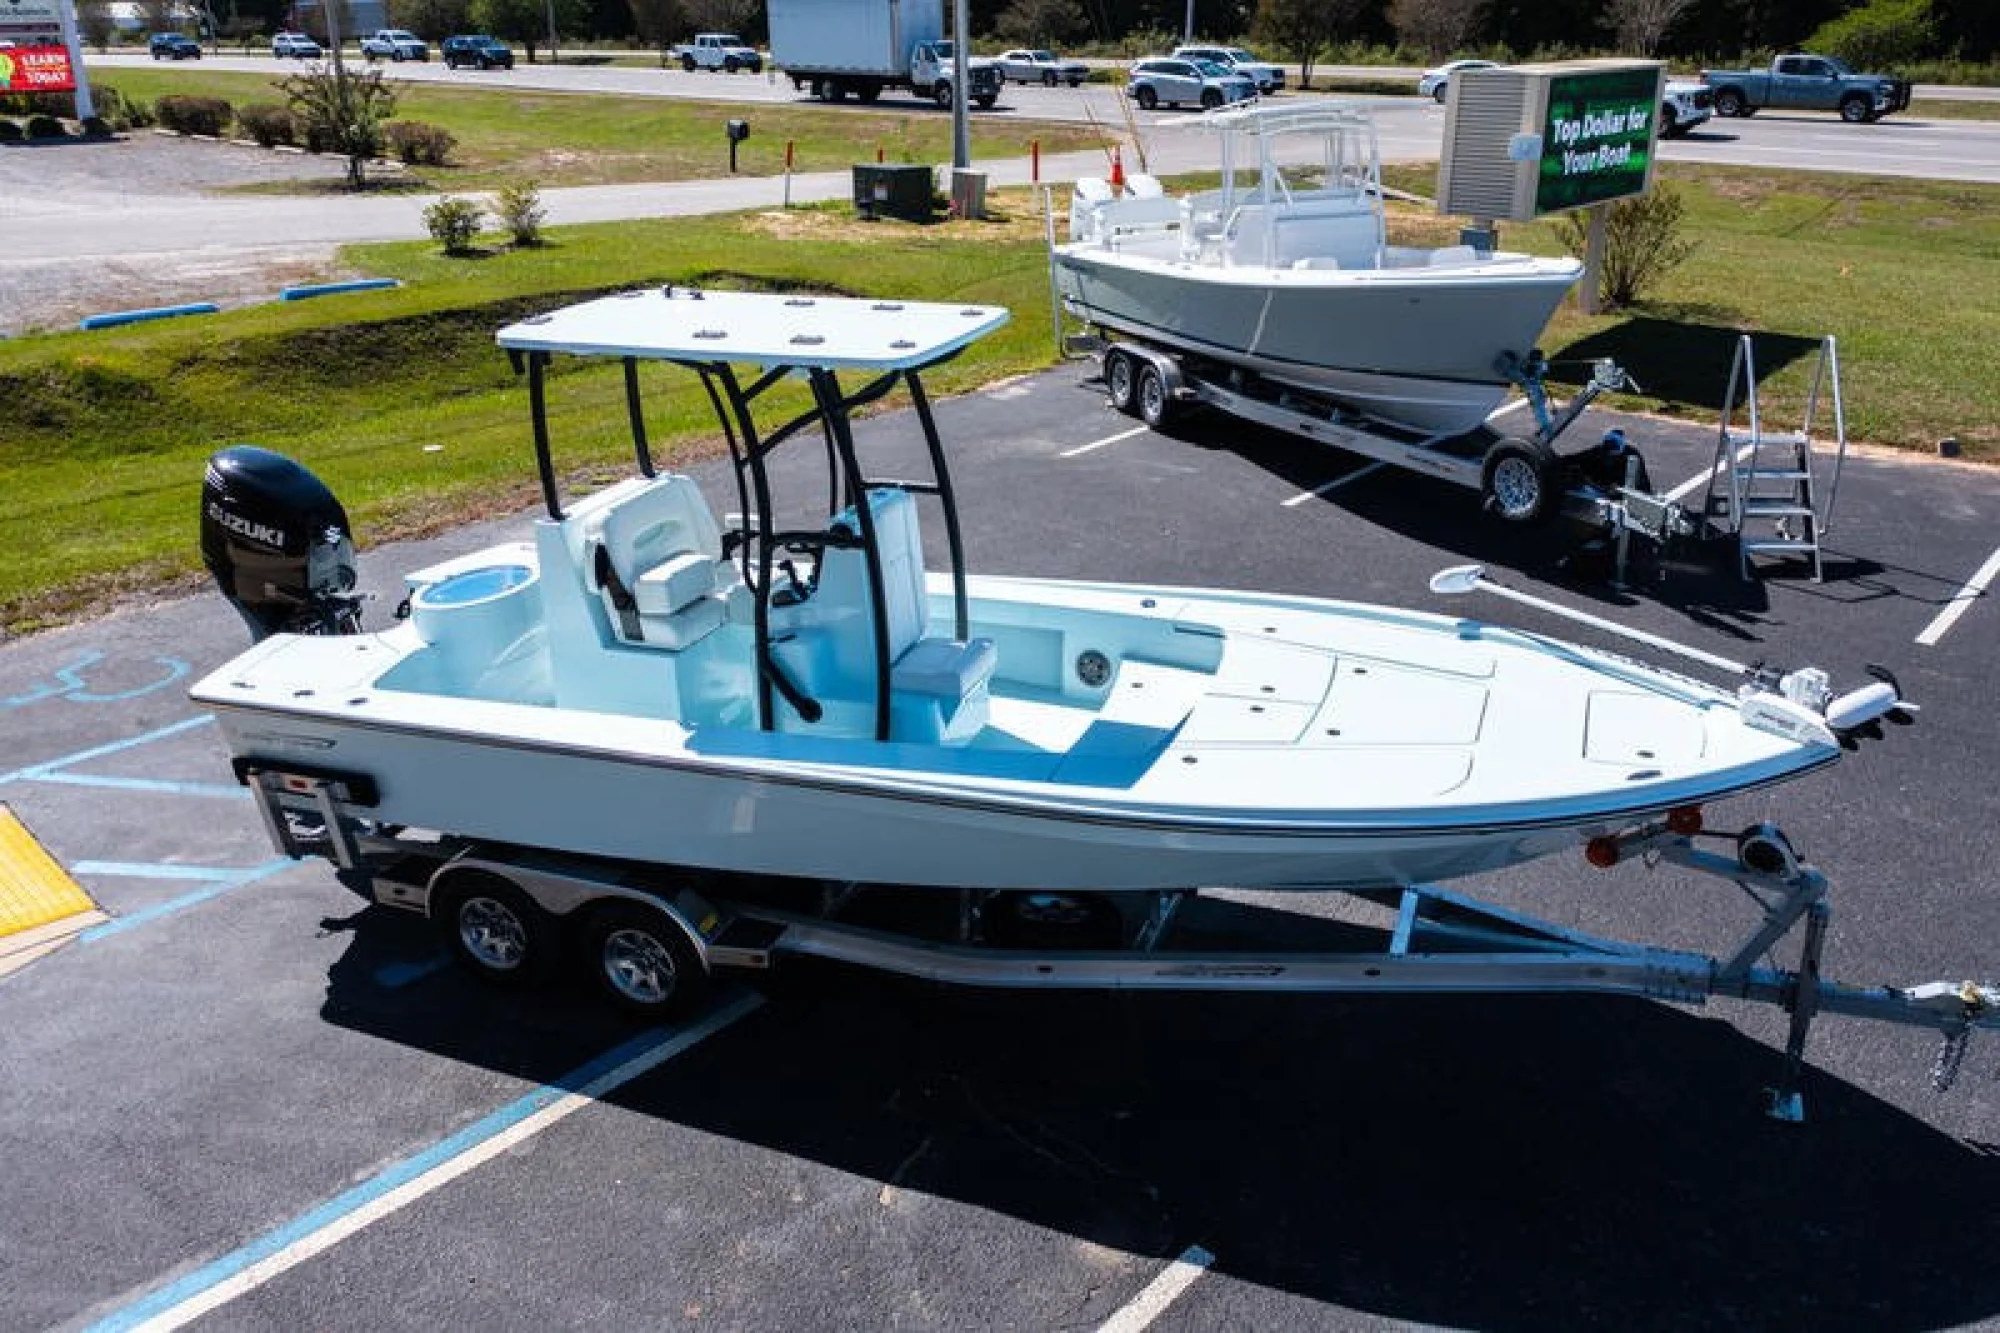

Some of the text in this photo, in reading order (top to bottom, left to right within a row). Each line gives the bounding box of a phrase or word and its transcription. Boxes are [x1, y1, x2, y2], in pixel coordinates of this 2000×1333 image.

[21, 54, 66, 66] LEARN
[25, 71, 66, 84] TODAY
[1554, 106, 1649, 145] Top Dollar for
[1564, 141, 1631, 175] Your Boat
[209, 502, 286, 546] SUZUKI
